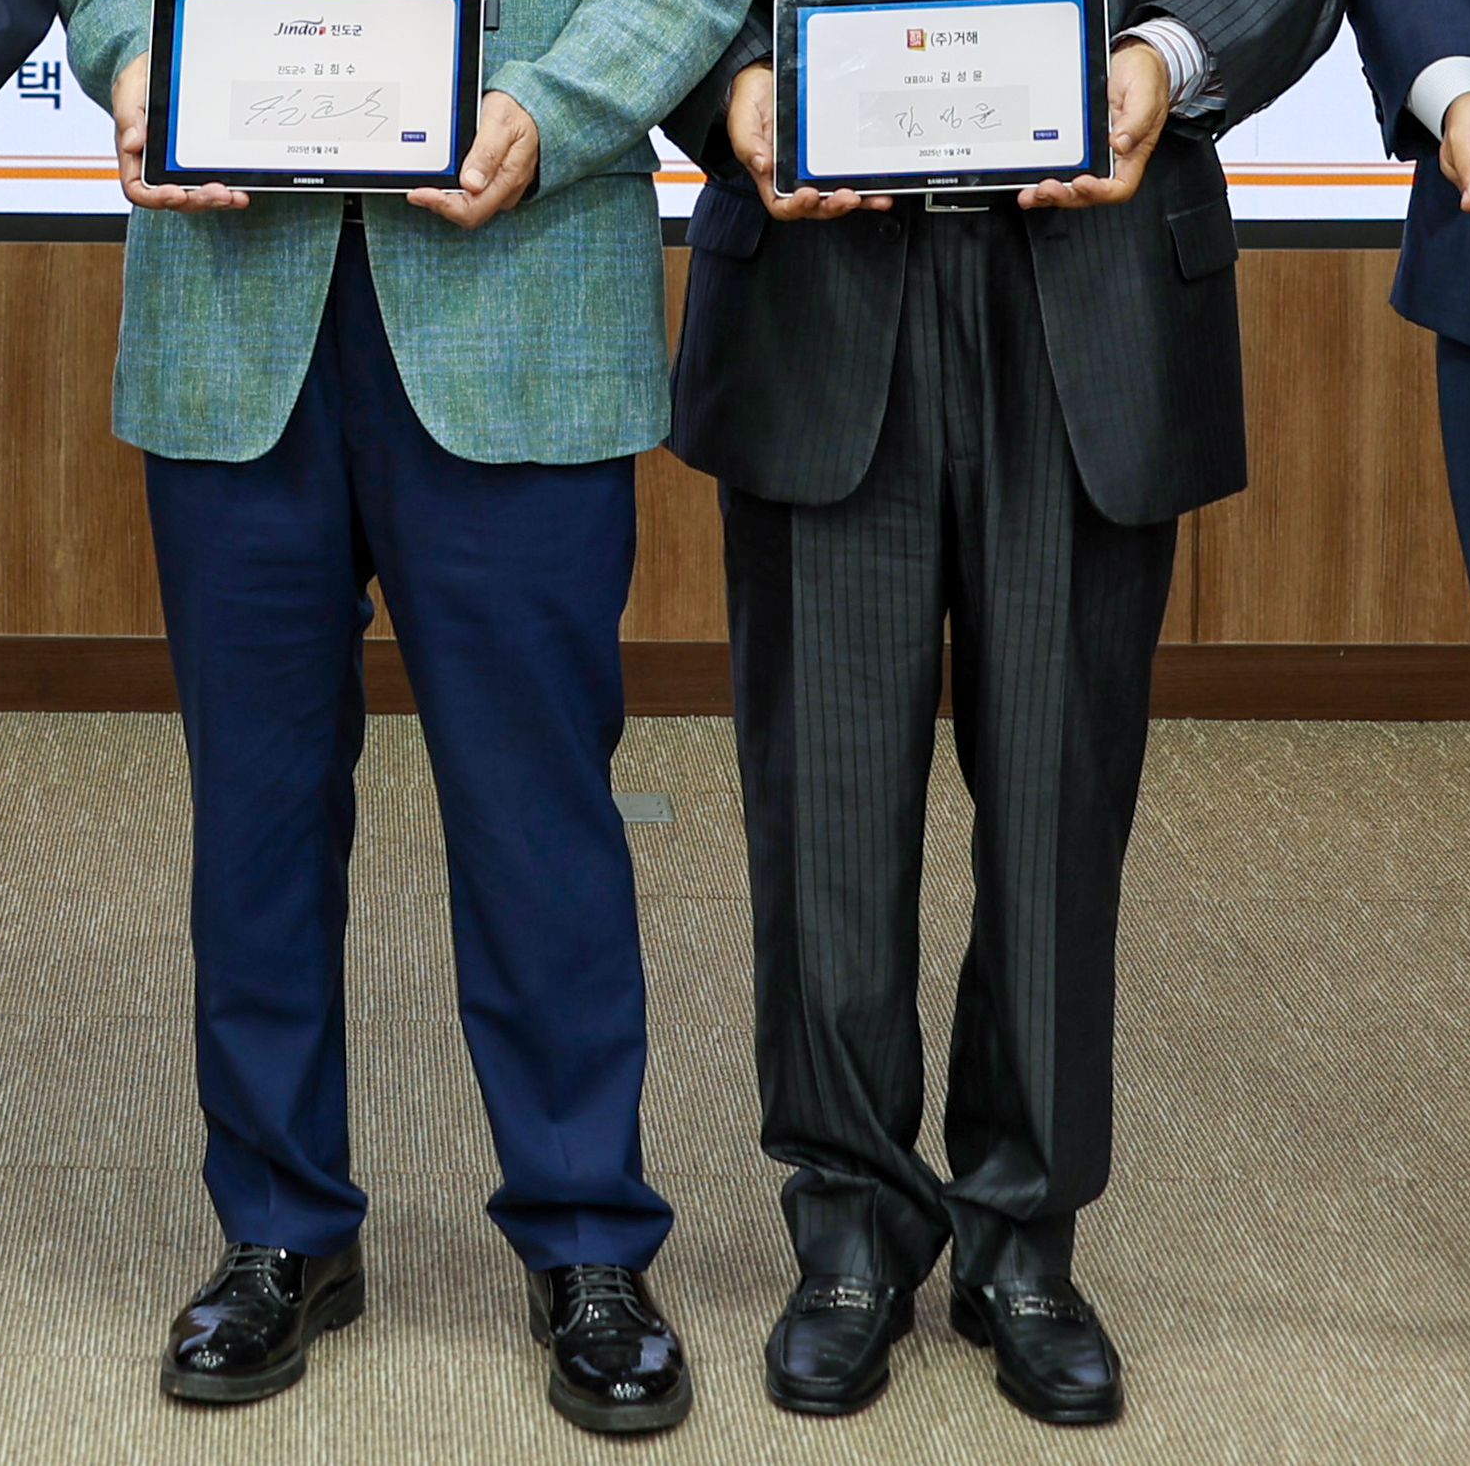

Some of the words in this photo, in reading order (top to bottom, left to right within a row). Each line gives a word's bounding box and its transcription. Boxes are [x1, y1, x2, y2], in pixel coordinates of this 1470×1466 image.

[273, 19, 320, 37] Jindo
[330, 24, 363, 37] 진도군
[930, 31, 978, 47] (주)거해
[277, 65, 307, 76] 진도군수
[904, 75, 934, 85] 대표이사
[286, 145, 310, 155] 2025년
[311, 146, 322, 155] 9월
[324, 146, 339, 155] 24일
[918, 149, 942, 158] 2025년
[956, 147, 971, 156] 24일
[292, 177, 325, 185] SAMSUNG
[927, 177, 959, 185] SAMSUNG
